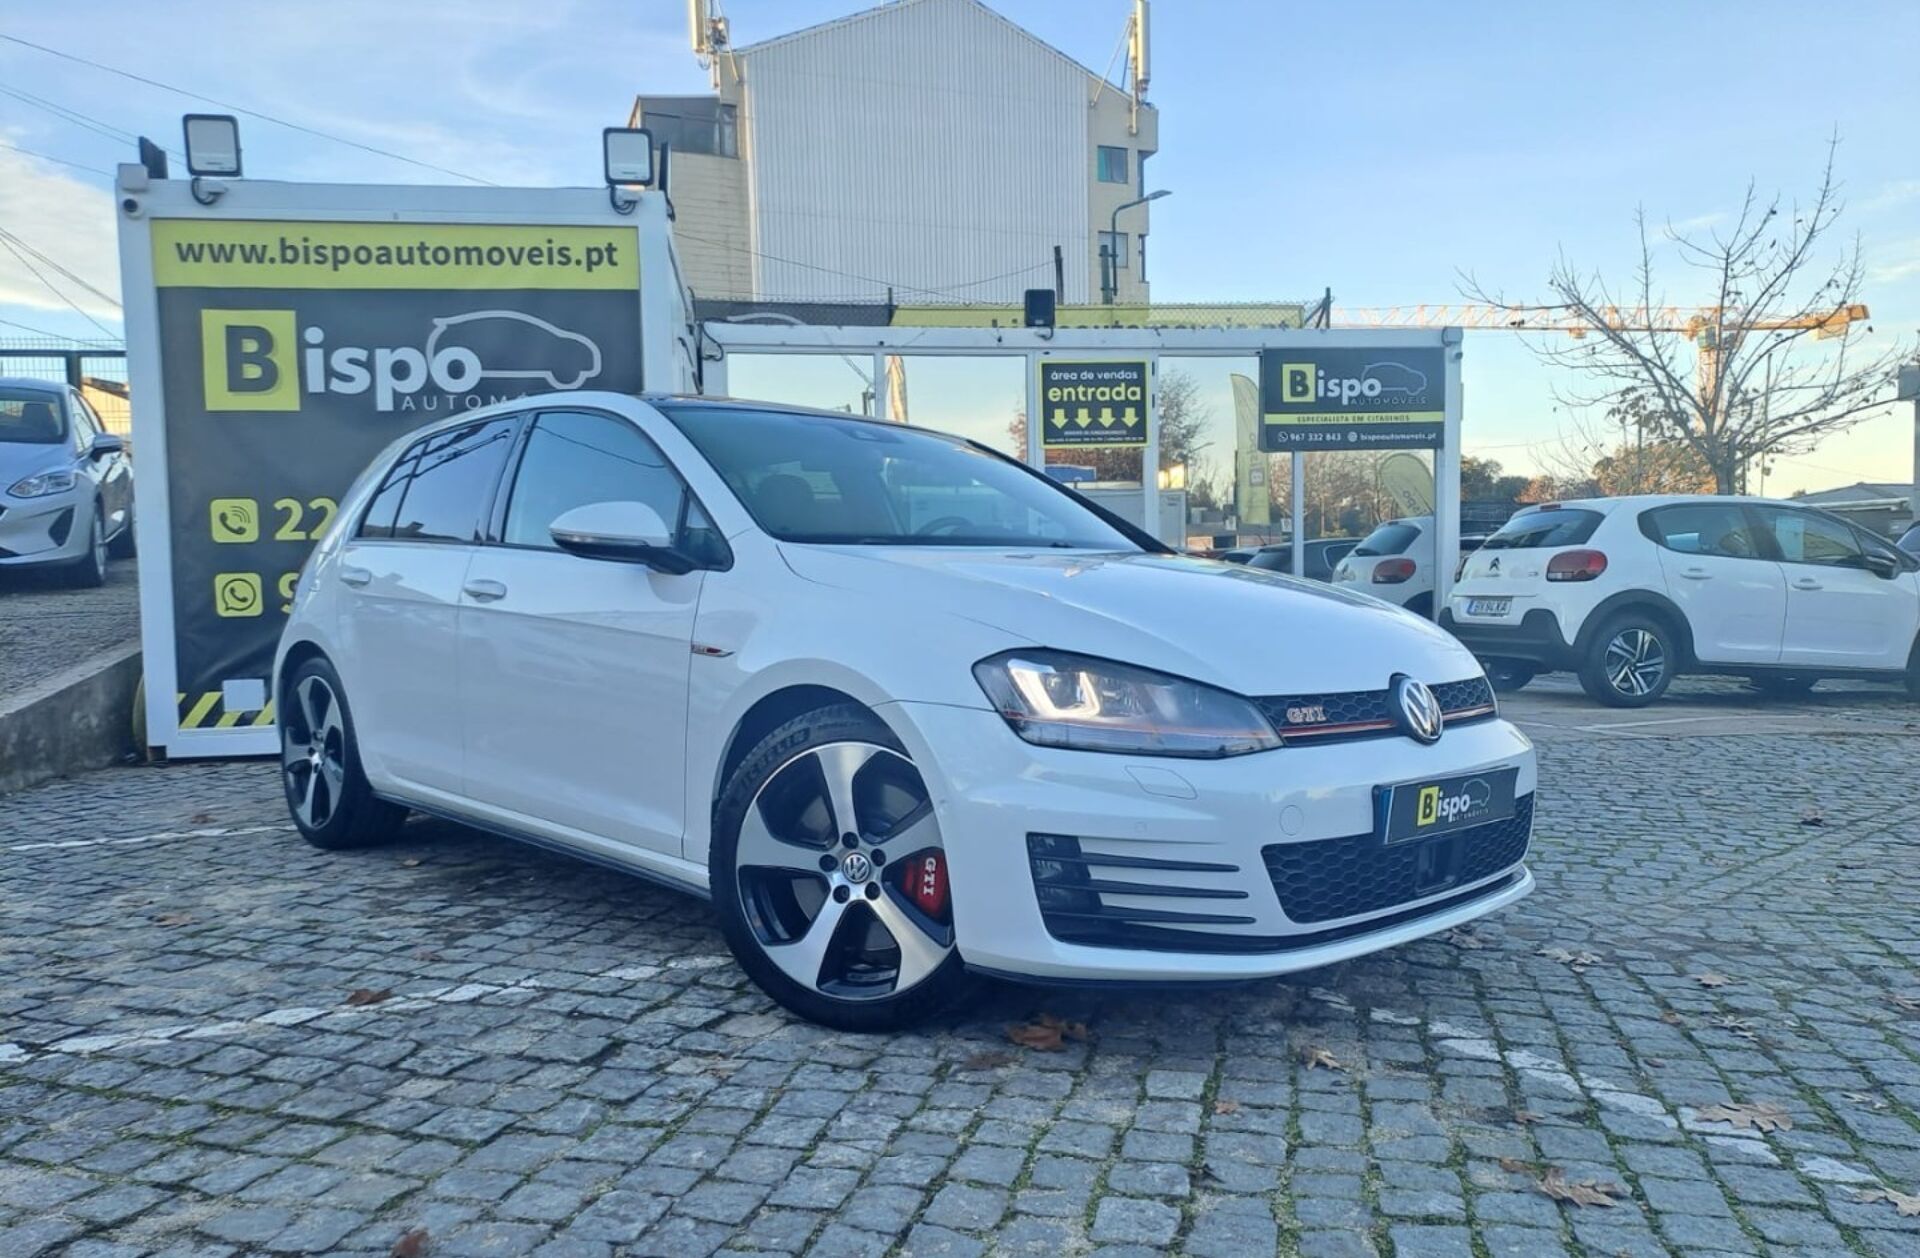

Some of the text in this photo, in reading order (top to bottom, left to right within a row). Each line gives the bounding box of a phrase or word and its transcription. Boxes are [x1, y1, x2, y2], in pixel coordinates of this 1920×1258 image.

[175, 237, 618, 273] www.bispoautomoveis.pt
[225, 324, 482, 412] Bispo
[1051, 369, 1138, 380] área de vendas
[1048, 382, 1141, 402] entrada
[1289, 369, 1382, 405] Bispo
[1297, 415, 1349, 423] ESPECIALISTA
[1352, 415, 1364, 423] EM
[1286, 705, 1327, 723] GTI
[1421, 790, 1471, 822] Bispo
[923, 857, 937, 896] GTI
